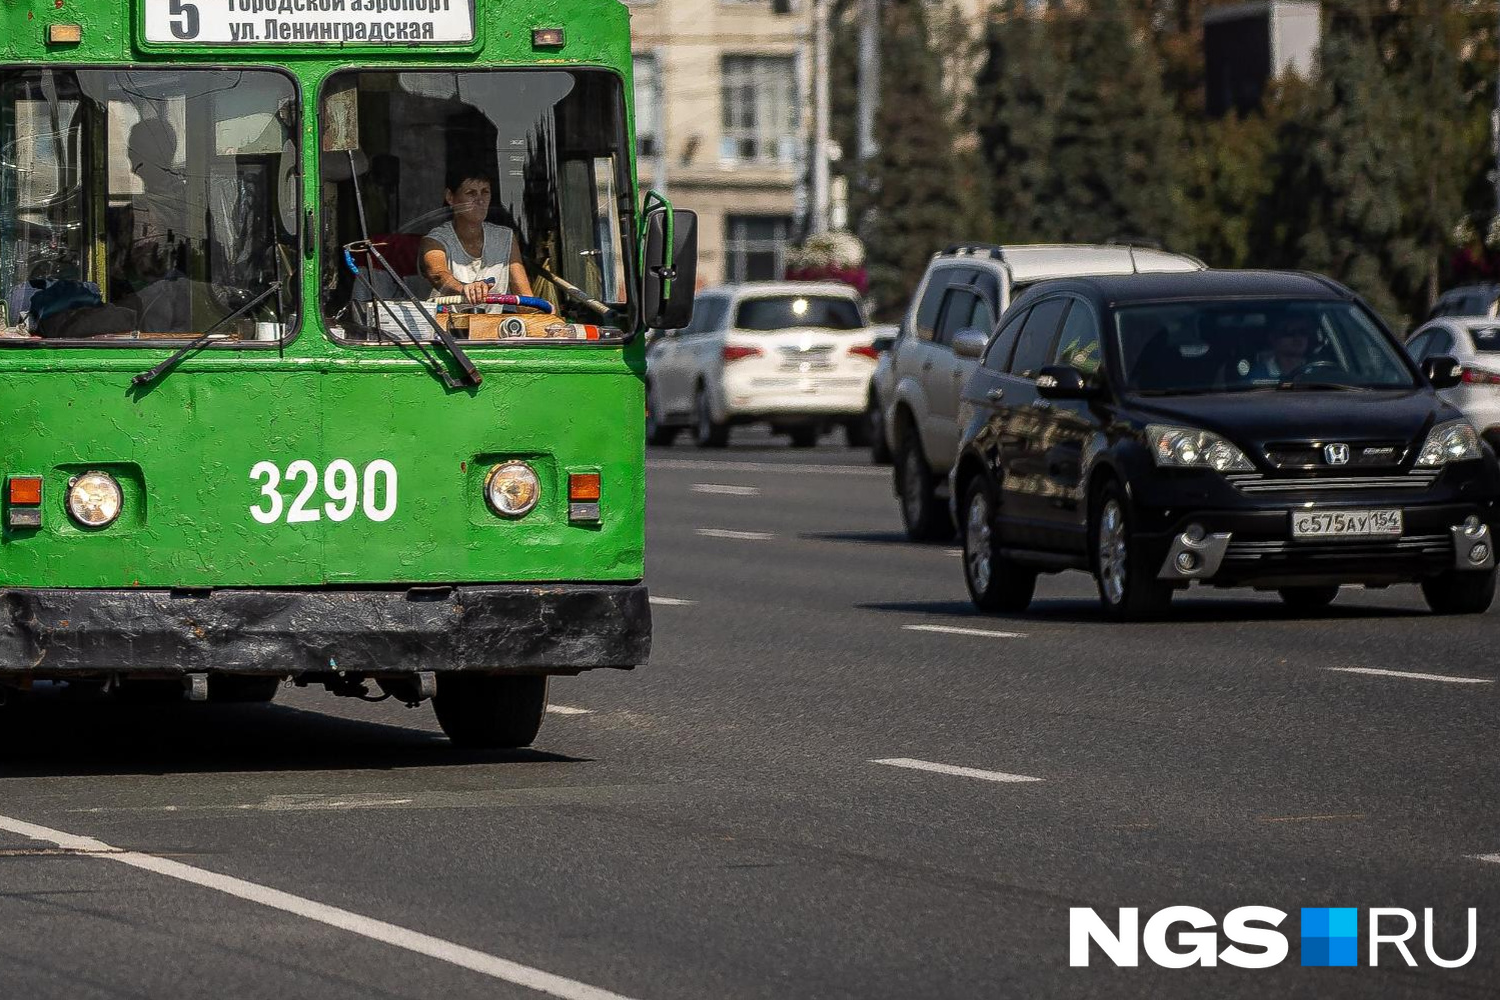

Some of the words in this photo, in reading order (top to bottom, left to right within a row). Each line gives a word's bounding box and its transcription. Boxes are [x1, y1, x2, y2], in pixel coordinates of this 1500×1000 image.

[228, 22, 260, 41] ул.
[264, 19, 434, 41] Ленинградская
[249, 458, 398, 524] 3290
